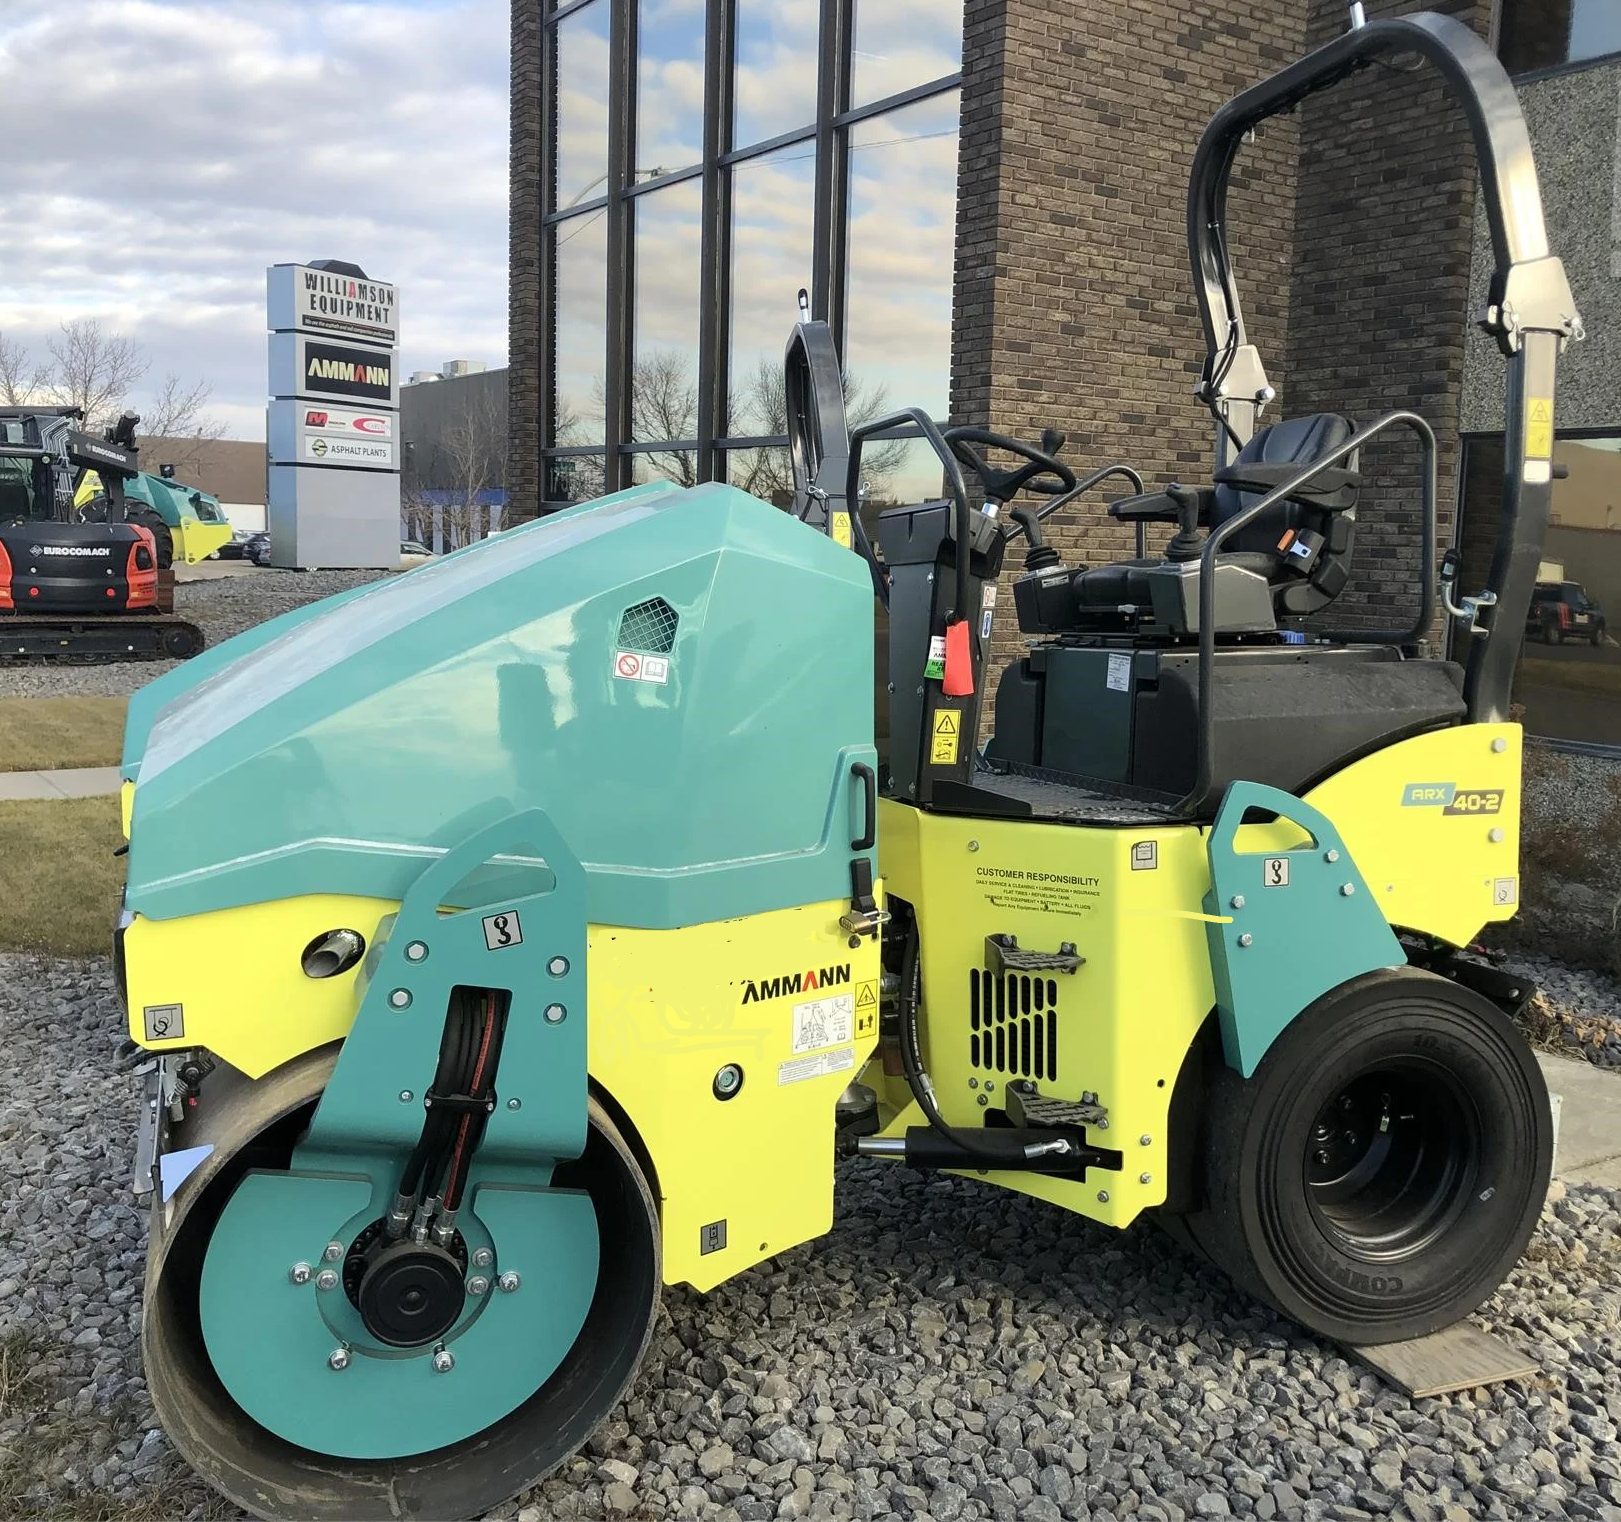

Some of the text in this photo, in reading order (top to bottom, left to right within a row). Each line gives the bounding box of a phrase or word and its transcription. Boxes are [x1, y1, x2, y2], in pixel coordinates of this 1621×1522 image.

[304, 272, 394, 306] WILLIAMSON
[310, 293, 390, 324] EQUIPMENT
[308, 357, 390, 387] AMMANN
[92, 445, 127, 463] EUROCOMACH
[331, 445, 387, 458] ASPHALT PLANTS
[43, 547, 110, 556] EUROCOMACH
[1411, 788, 1446, 801] ARX
[1453, 793, 1500, 811] 40-2
[976, 867, 1100, 887] CUSTOMER RESPONSIBILITY
[1073, 889, 1100, 897] INSURANCE
[741, 963, 851, 1005] AMMANN
